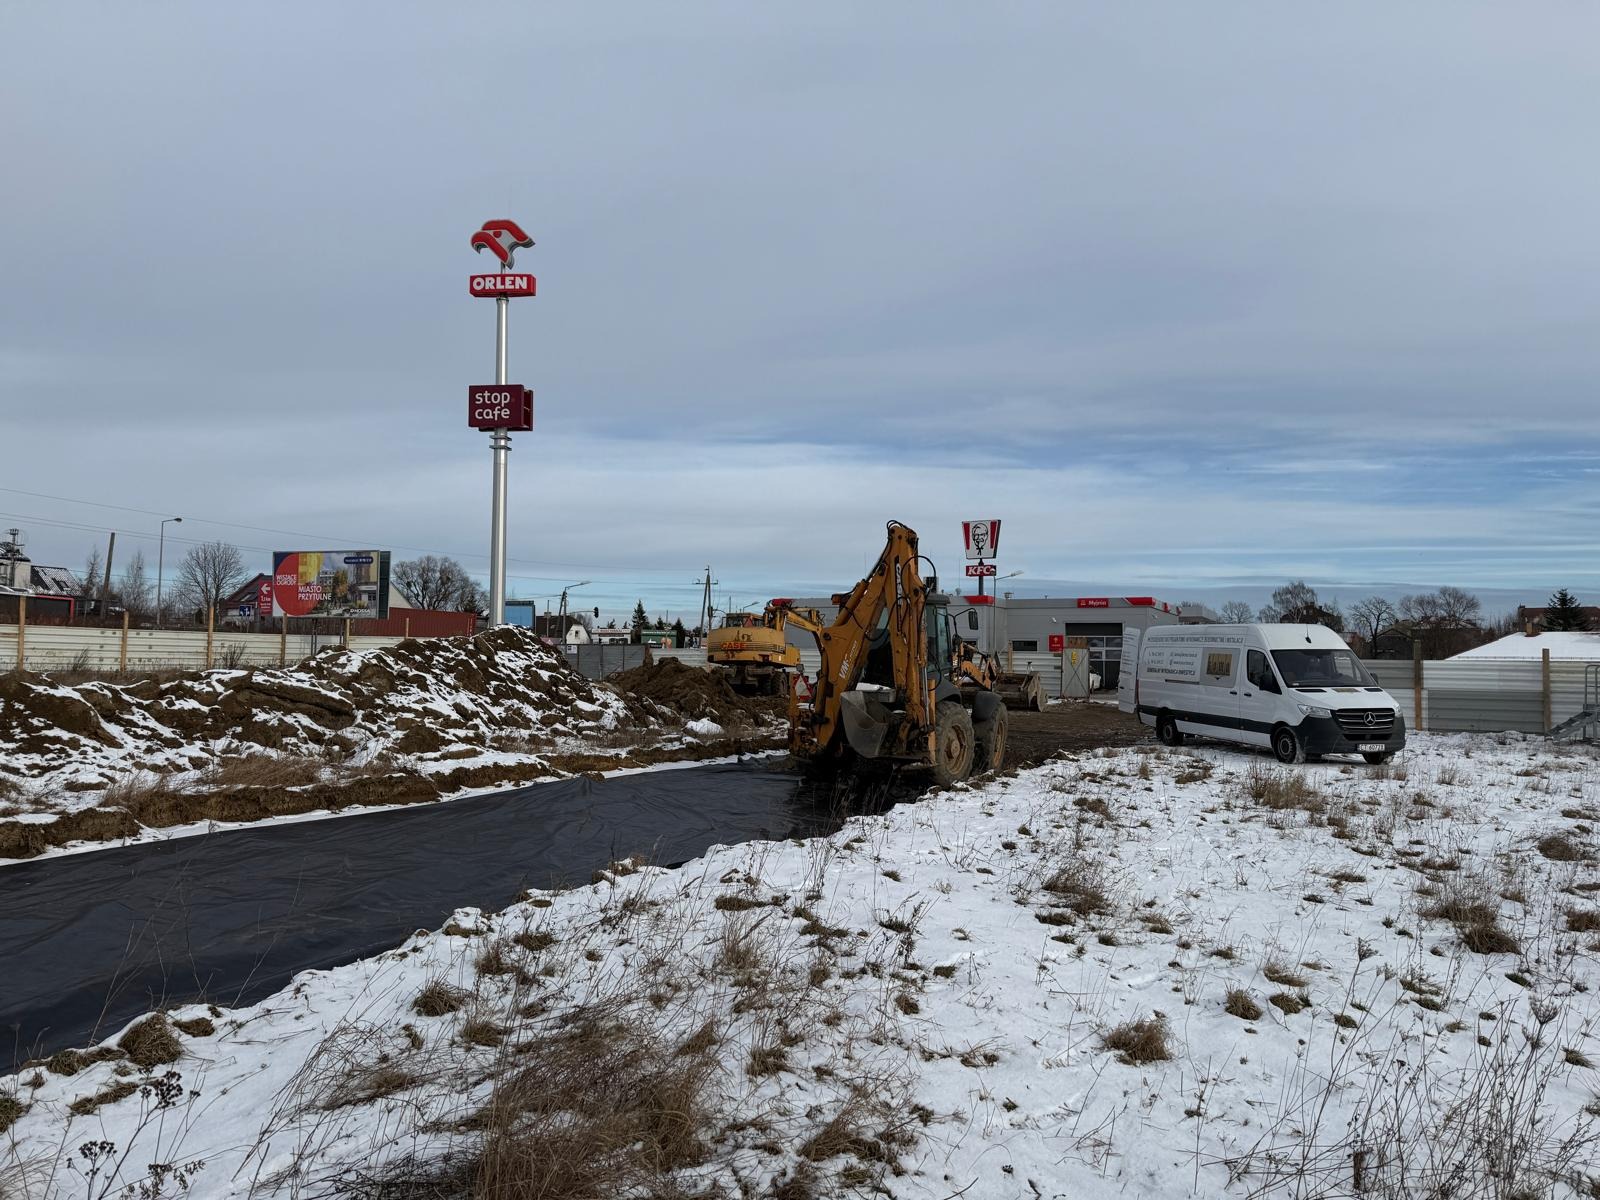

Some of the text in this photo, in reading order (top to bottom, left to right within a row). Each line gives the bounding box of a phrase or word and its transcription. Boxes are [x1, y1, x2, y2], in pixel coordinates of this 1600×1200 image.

[472, 276, 528, 290] ORLEN
[475, 390, 510, 407] stop
[475, 406, 510, 421] cafe
[967, 565, 991, 576] KFC
[298, 585, 322, 593] MIASTO
[298, 593, 332, 601] PRZYTULNE
[720, 642, 746, 650] CASE
